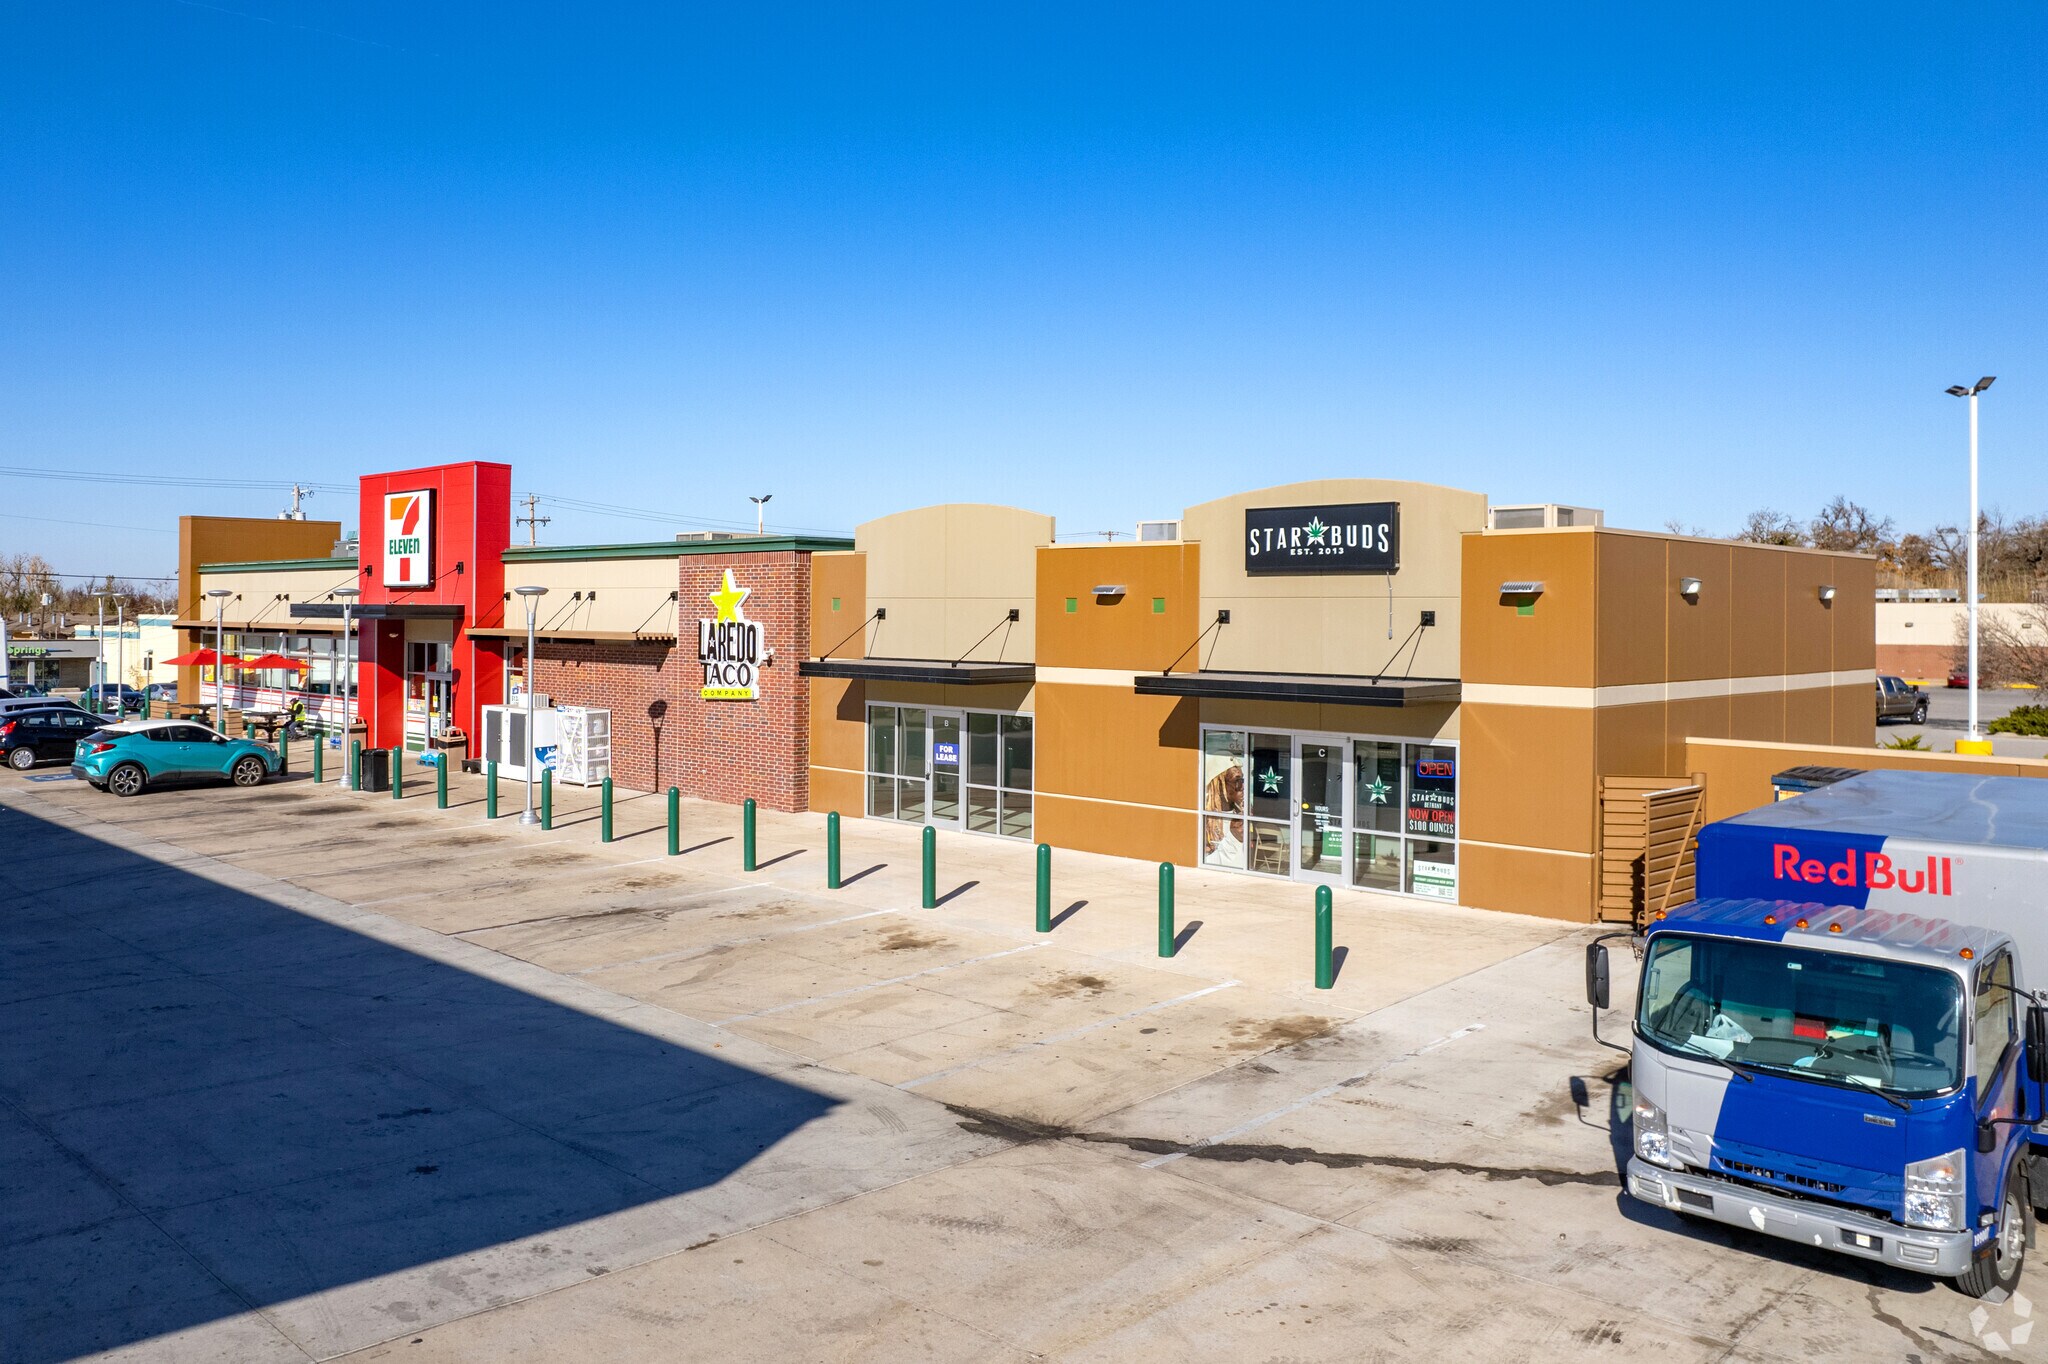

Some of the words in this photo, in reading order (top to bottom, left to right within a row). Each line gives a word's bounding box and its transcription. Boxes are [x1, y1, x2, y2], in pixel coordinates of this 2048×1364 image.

[1250, 527, 1301, 556] STAR
[1331, 523, 1389, 553] BUDS
[1290, 548, 1314, 556] EST.
[1318, 547, 1344, 555] 2013
[698, 621, 757, 665] LAREDO
[7, 645, 46, 656] Springs
[700, 663, 751, 687] TACO
[939, 745, 953, 753] FOR
[1318, 749, 1326, 757] C
[935, 753, 957, 762] LEASE
[1420, 762, 1453, 775] OPEN
[1411, 793, 1429, 802] STAR
[1437, 795, 1455, 806] BUDS
[1408, 808, 1429, 820] NOW
[1409, 819, 1427, 831] $100
[1429, 821, 1454, 834] OUNCES
[1773, 843, 1857, 887] Red
[1865, 852, 1952, 896] Bull
